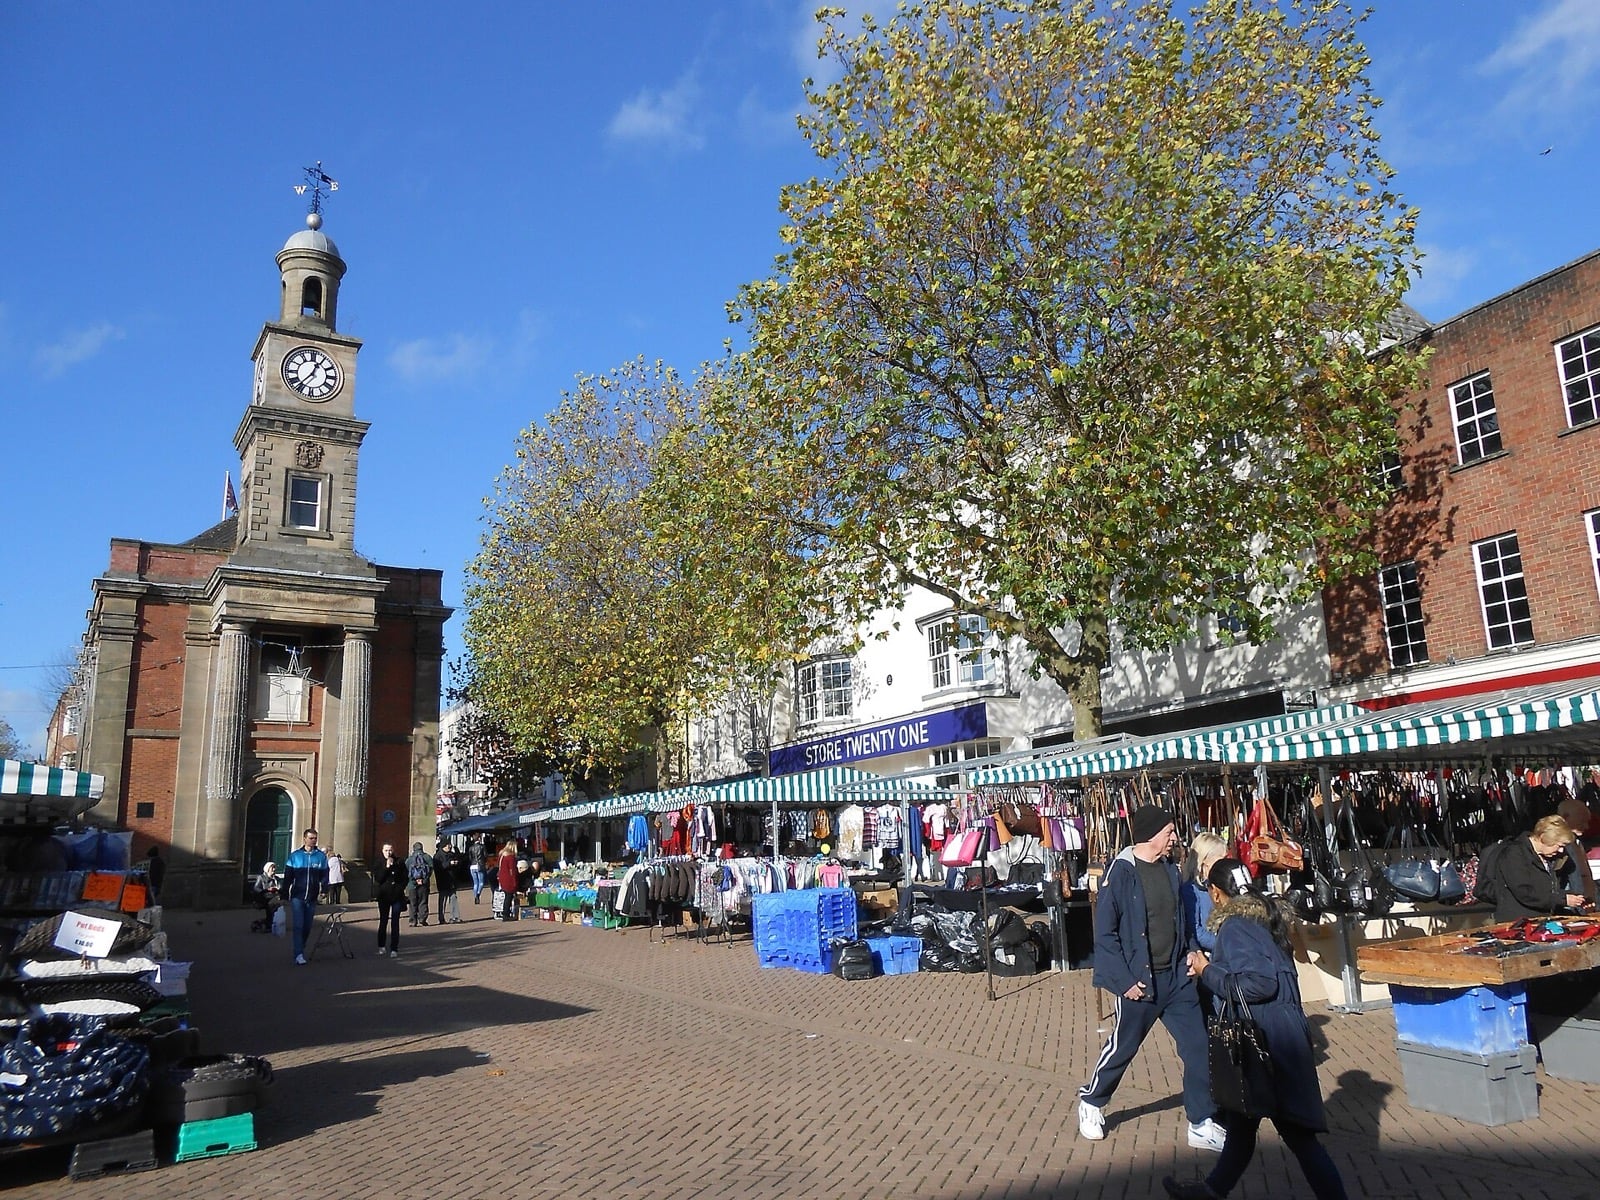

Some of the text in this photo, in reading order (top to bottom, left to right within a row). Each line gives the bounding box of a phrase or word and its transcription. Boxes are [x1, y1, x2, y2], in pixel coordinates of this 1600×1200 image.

[293, 185, 307, 195] W
[330, 182, 339, 191] E
[805, 720, 930, 766] STORE TWENTY ONE
